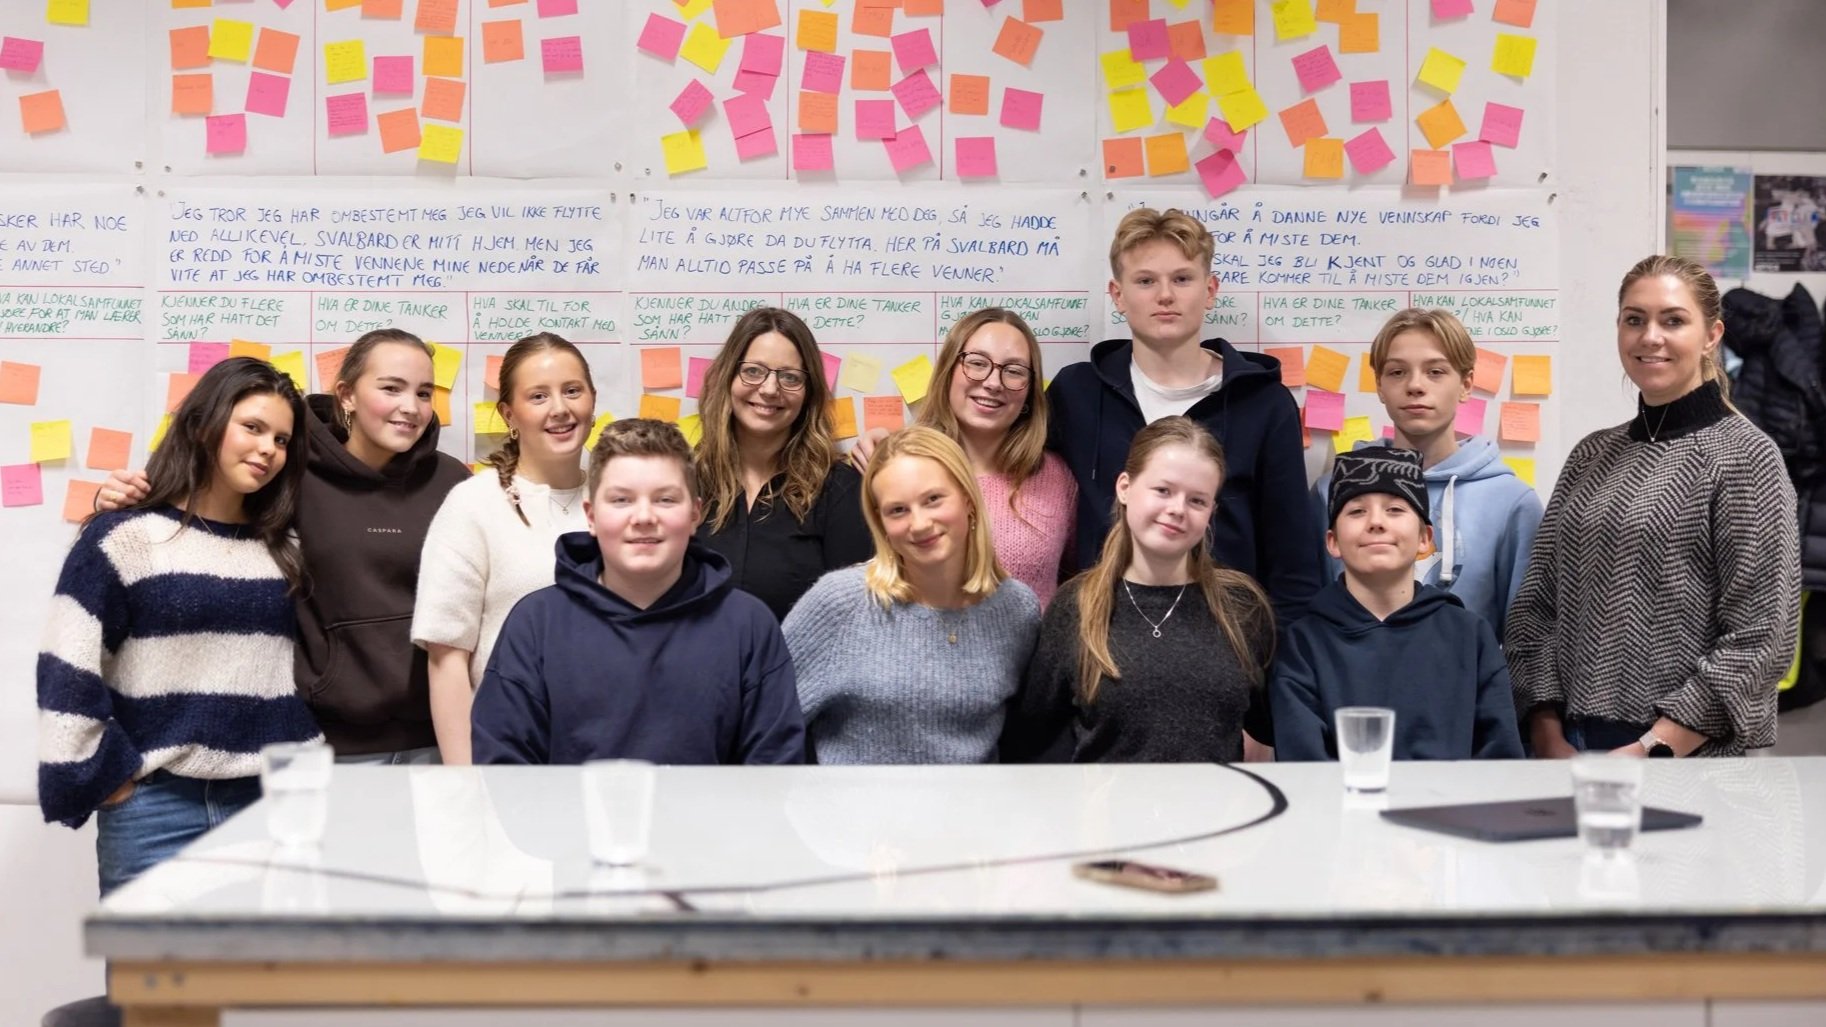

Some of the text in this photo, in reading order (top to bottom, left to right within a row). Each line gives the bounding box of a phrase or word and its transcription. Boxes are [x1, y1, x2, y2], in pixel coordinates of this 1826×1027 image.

[50, 212, 127, 231] HAR NOE
[209, 207, 247, 223] TROR
[257, 208, 282, 223] JEG
[291, 208, 320, 224] HAR
[331, 207, 418, 222] OMBESTEMT
[458, 206, 486, 221] JEG
[491, 206, 514, 218] VIL
[522, 206, 546, 218] IKKE
[554, 206, 602, 220] FLYTTE
[686, 207, 712, 221] VAR
[720, 207, 772, 224] ALTFOR
[780, 206, 811, 221] MYE
[820, 205, 875, 222] SAMMEN
[881, 207, 909, 221] MED
[948, 205, 968, 224] SÅ
[978, 212, 1002, 229] JEG
[1011, 215, 1057, 230] HADDE
[1252, 202, 1541, 228] Å DANNE NYE VENNSKAP FORDI JEG
[169, 231, 198, 244] NED
[314, 230, 398, 250] SVALBARD
[403, 234, 421, 249] ER
[429, 234, 462, 250] MITT
[525, 236, 559, 252] MEN
[568, 239, 593, 252] JEG
[640, 228, 675, 244] LITE
[686, 226, 697, 244] Å
[705, 232, 754, 247] GJØRE
[765, 234, 786, 247] DA
[793, 236, 816, 249] DU
[885, 237, 919, 253] HER
[922, 232, 941, 251] PÅ
[946, 238, 1028, 256] SVALBARD
[1036, 236, 1060, 256] MÅ
[1210, 228, 1360, 246] FOR Å MISTE DEM.
[17, 240, 36, 252] AV
[12, 259, 64, 271] ANNET
[170, 245, 600, 275] ER REDD FOR Å MISTE VENNENE MINE NEDE NÅR DE FÅR
[637, 254, 920, 279] MAN ALLTID PASSE PÅ Å HA FLERE
[1213, 253, 1249, 266] SKAL
[1258, 254, 1282, 267] JEG
[1293, 256, 1317, 268] BLI
[1328, 256, 1387, 270] KJENT
[1397, 256, 1415, 268] OG
[1425, 255, 1461, 269] GLAD
[171, 269, 201, 281] VITE
[210, 269, 228, 282] AT
[233, 271, 259, 281] JEG
[267, 270, 296, 282] HAR
[302, 272, 404, 288] OMBESTEMT
[1259, 269, 1449, 286] KOMMER TIL Å MISTE DEM
[17, 293, 39, 304] KAN
[161, 296, 285, 312] KJENNER DU FLERE
[474, 296, 592, 313] HVA SKAL TIL FOR
[634, 297, 694, 310] KJENNER
[697, 299, 720, 311] DU
[788, 297, 922, 313] HVA ER DINE TANKER
[941, 297, 963, 309] HVA
[968, 296, 994, 309] KAN
[1264, 295, 1398, 310] HVA ER DINE TANKER
[1413, 295, 1557, 309] HVA KAN LOKALSAMFUNNET
[27, 308, 142, 324] FOR AT MAN LÆRER
[318, 297, 448, 319] HVA ER DINE TANKER
[1473, 310, 1493, 322] HVA
[1499, 311, 1523, 321] KAN
[162, 313, 281, 327] SOM HAR HATT DET
[316, 320, 338, 332] OM
[473, 312, 615, 332] Å HOLDE KONTAKT MED
[634, 313, 661, 327] SOM
[670, 313, 693, 324] HAR
[698, 314, 734, 324] HATT
[814, 316, 864, 329] DETTE?
[1264, 314, 1342, 327] OM DETTE?
[163, 327, 208, 340] SÅNN?
[639, 324, 691, 340] SÅNN?
[1494, 327, 1518, 336] OSLO
